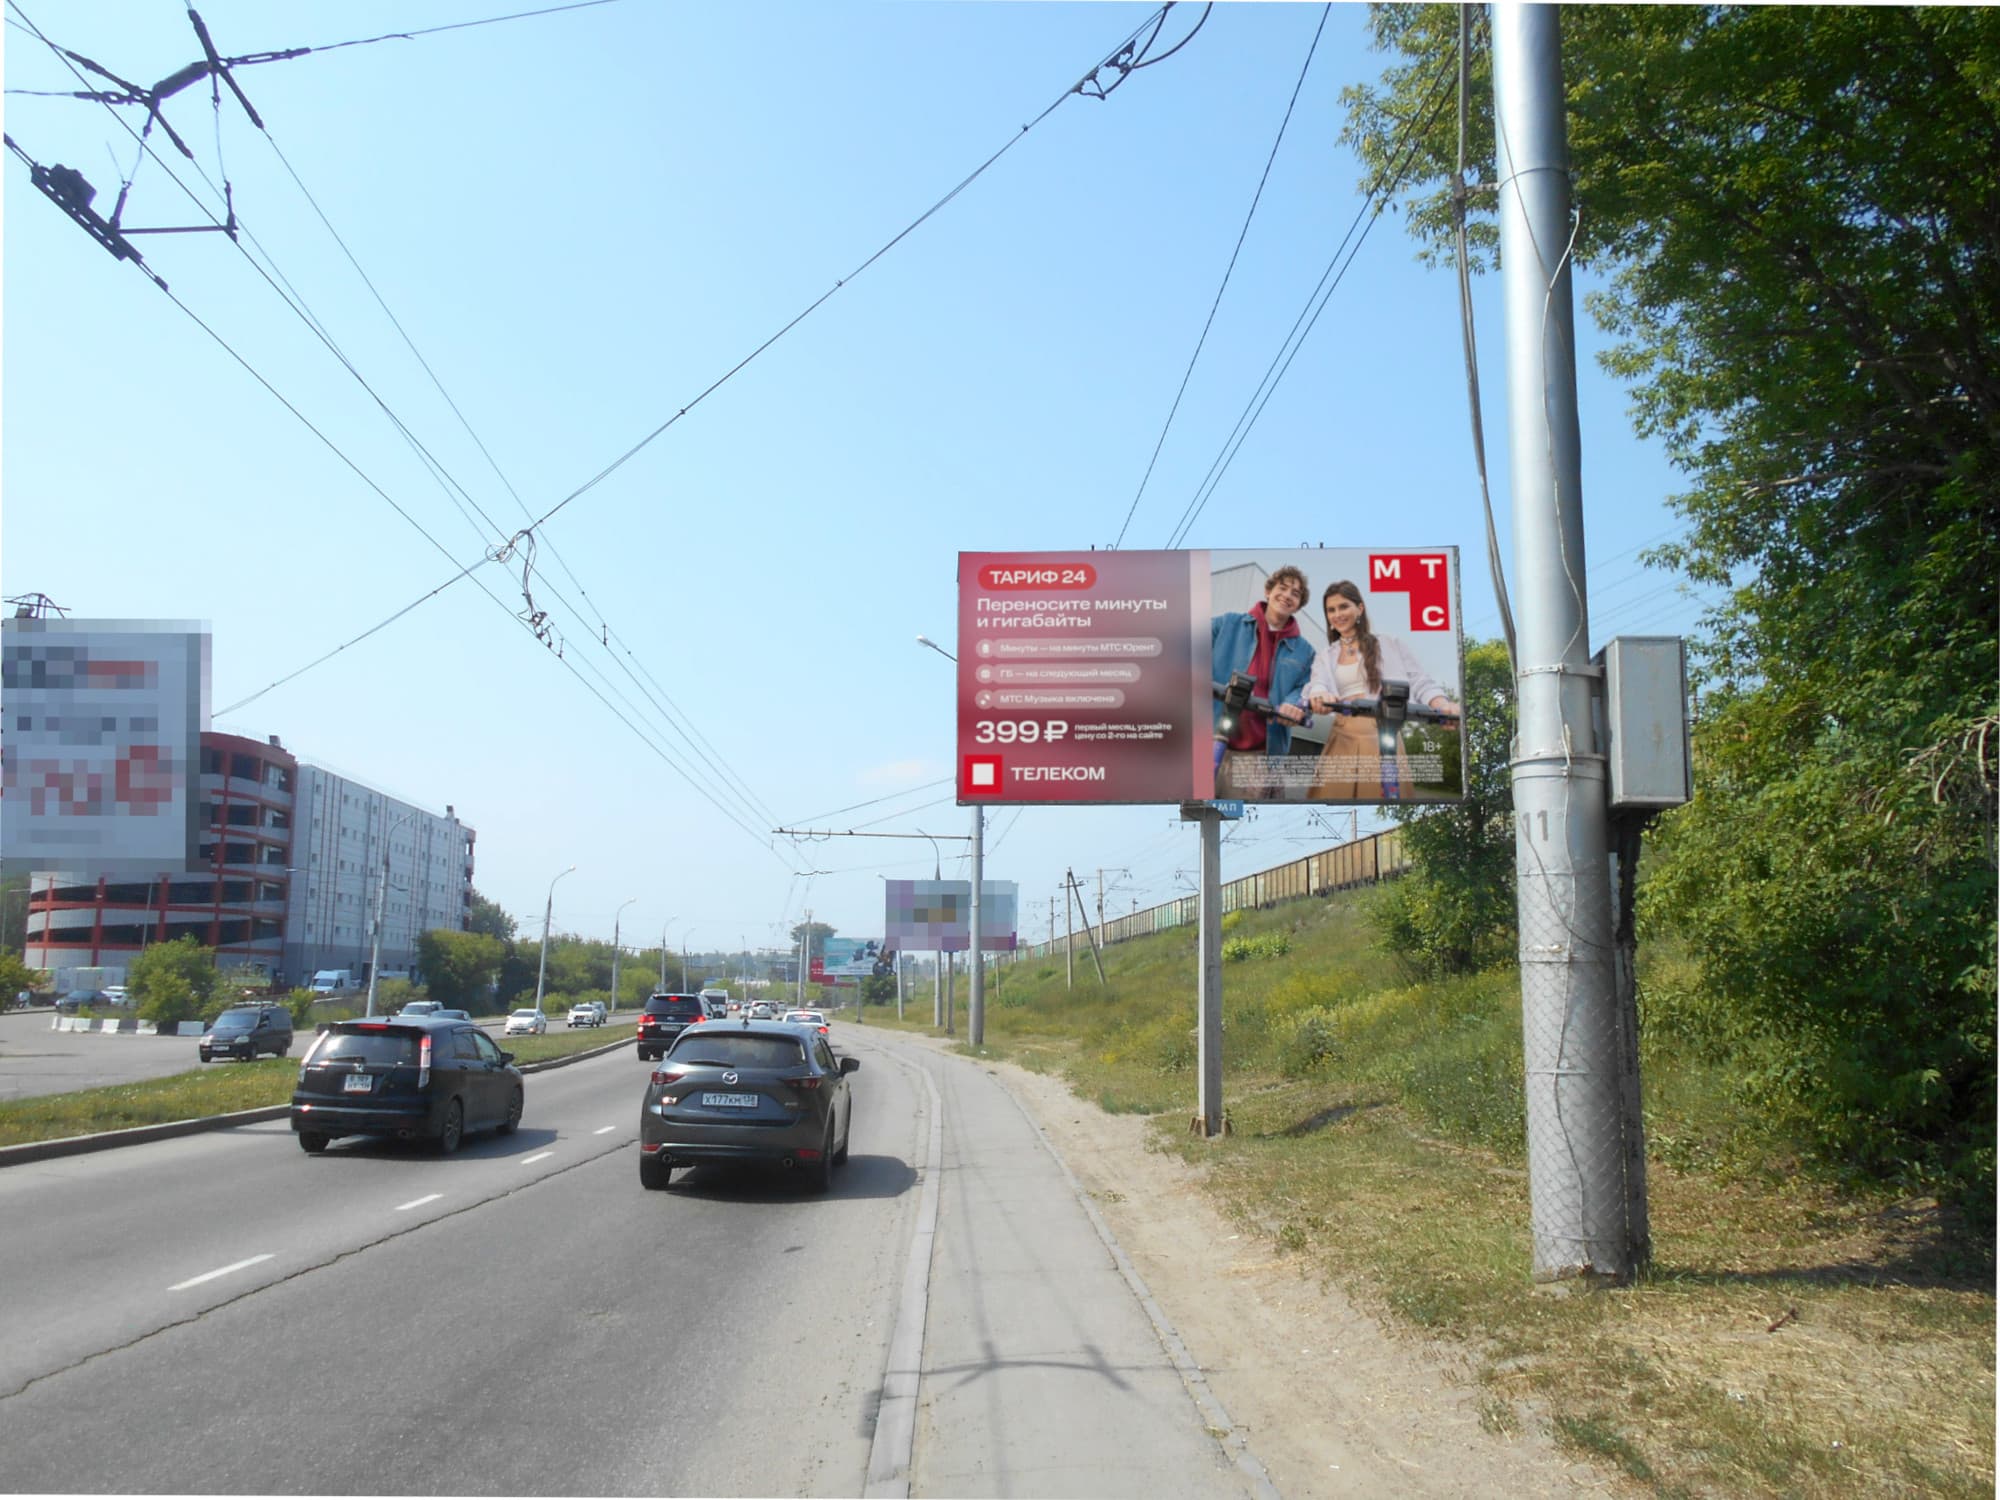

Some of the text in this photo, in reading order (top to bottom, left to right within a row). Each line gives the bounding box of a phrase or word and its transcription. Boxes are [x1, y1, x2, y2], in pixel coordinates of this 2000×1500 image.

[1373, 558, 1443, 580] М Т
[989, 569, 1087, 585] ТАРИФ 24
[976, 598, 1168, 614] Переносите минуты
[976, 613, 1092, 628] и гигабайты
[1421, 605, 1445, 627] С
[1000, 645, 1038, 654] Минуты
[1063, 644, 1099, 654] минуты
[1100, 643, 1121, 651] МТС
[1000, 669, 1014, 678] ГБ
[1039, 669, 1099, 680] следующий
[1100, 668, 1133, 679] месяц
[1000, 694, 1116, 705] МТС Музыка включена
[1074, 723, 1107, 732] первый
[1137, 723, 1172, 732] узнайте
[1074, 733, 1094, 741] цену
[1107, 732, 1126, 740] 2-го
[1139, 731, 1164, 740] сайте
[1422, 741, 1443, 752] 18+
[1011, 766, 1106, 781] ТЕЛЕКОМ
[1522, 810, 1549, 841] 11
